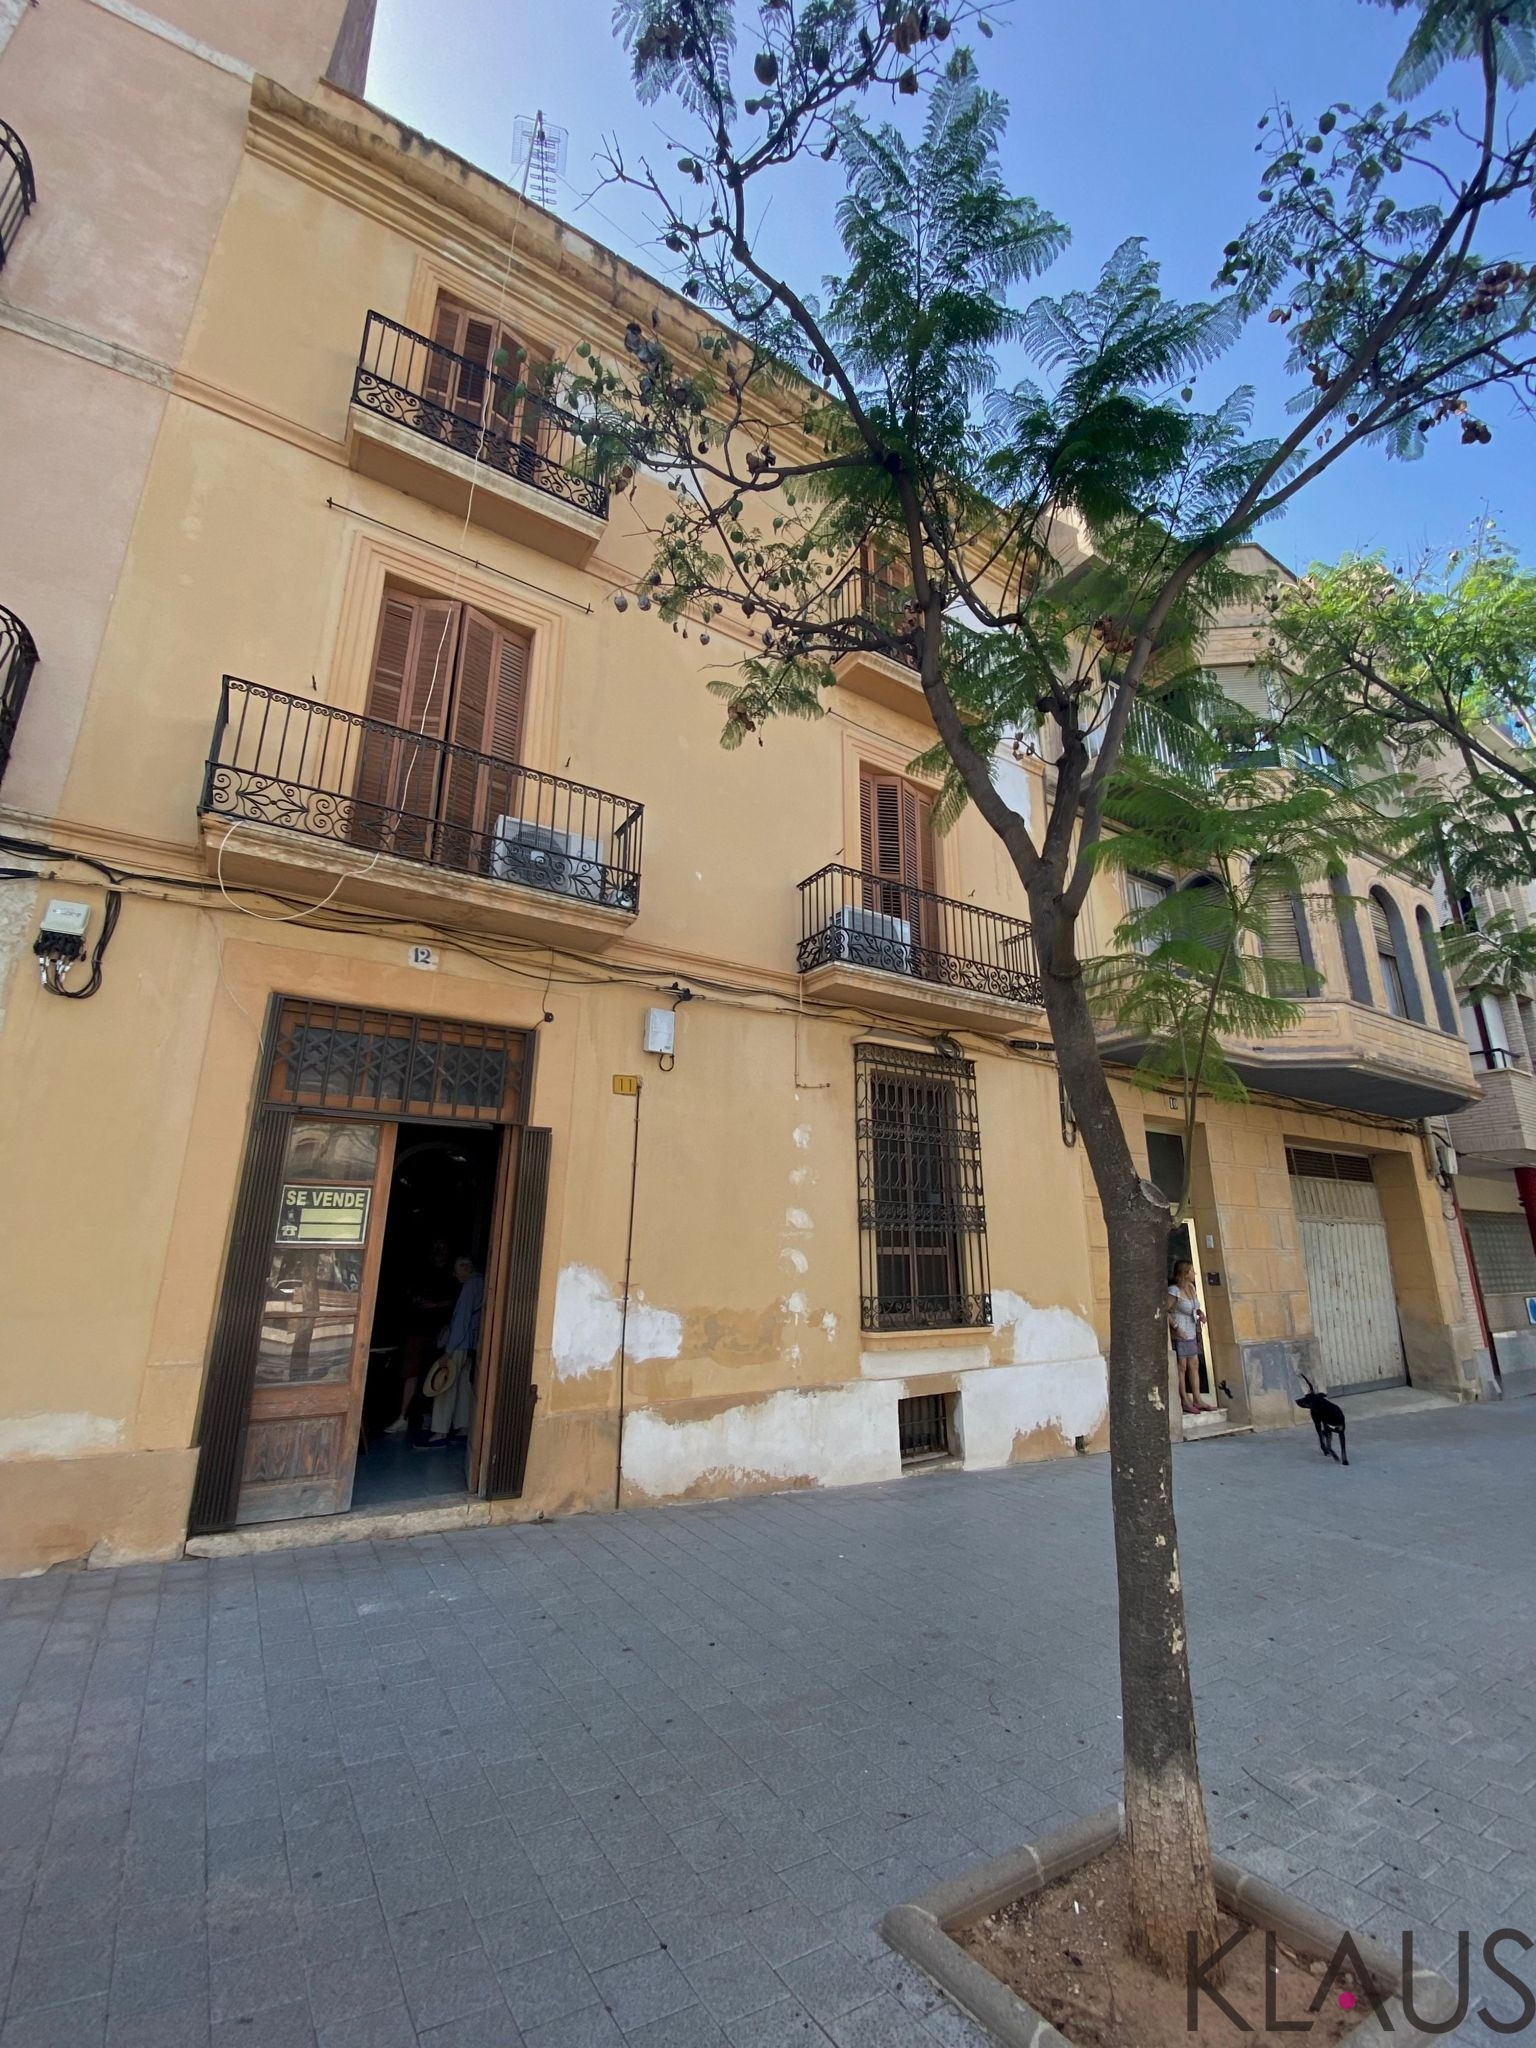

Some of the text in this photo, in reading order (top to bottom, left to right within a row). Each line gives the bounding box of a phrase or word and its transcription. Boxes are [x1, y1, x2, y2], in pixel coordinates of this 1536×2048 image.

[414, 947, 431, 965] 12
[286, 1190, 366, 1208] SE VENDE
